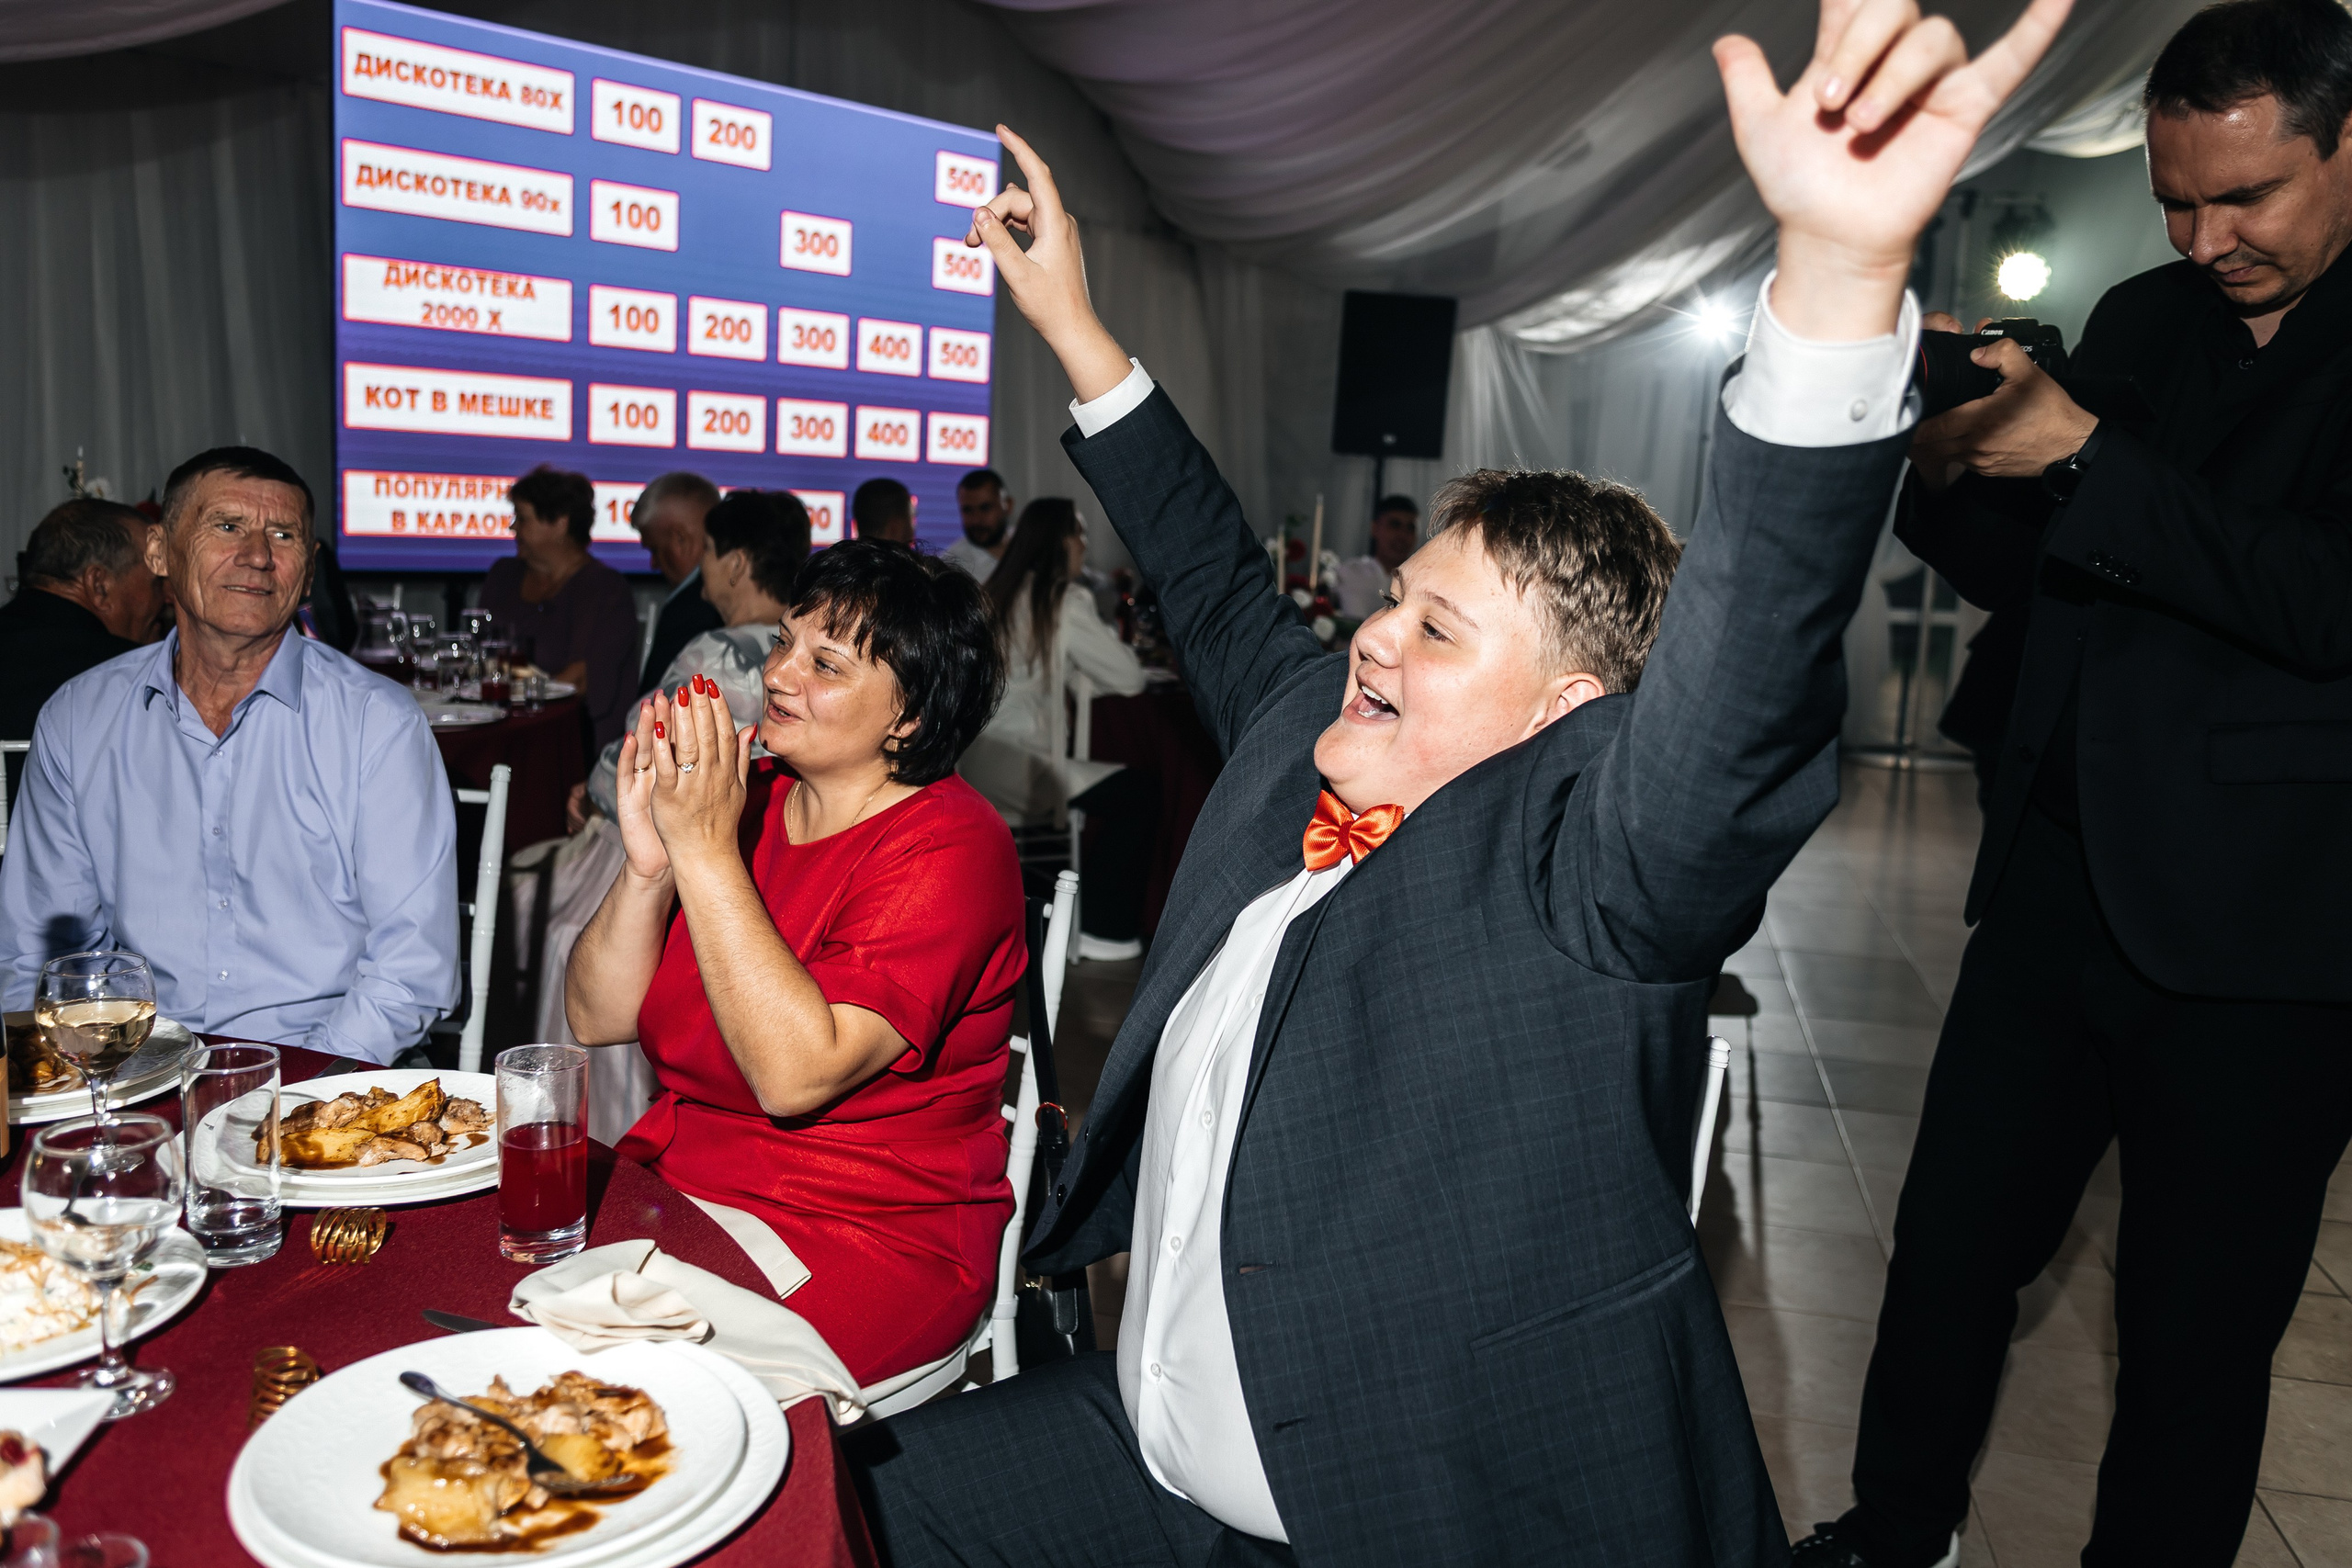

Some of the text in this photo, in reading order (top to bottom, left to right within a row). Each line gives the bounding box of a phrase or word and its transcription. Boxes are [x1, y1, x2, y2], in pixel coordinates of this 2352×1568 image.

[353, 51, 513, 101] ДИСКОТЕКА
[612, 99, 663, 134] 100
[707, 118, 757, 151] 200
[355, 164, 513, 206] ДИСКОТЕКА
[947, 165, 986, 195] 500
[610, 199, 662, 232] 100
[794, 229, 840, 259] 300
[382, 261, 537, 300] ДИСКОТЕКА
[944, 253, 982, 280] 500
[420, 302, 480, 327] 2000
[609, 303, 660, 333] 100
[705, 314, 752, 343] 200
[792, 324, 836, 353] 300
[869, 333, 910, 361] 400
[940, 342, 979, 368] 500
[365, 385, 555, 421] КОТ В МЕШКЕ
[608, 401, 660, 430] 100
[704, 408, 752, 435] 200
[790, 415, 834, 442] 300
[867, 422, 909, 446] 400
[938, 427, 978, 451] 500
[374, 477, 514, 501] ПОПУЛЯРН
[391, 511, 514, 536] В КАРАОК
[606, 499, 635, 525] 10
